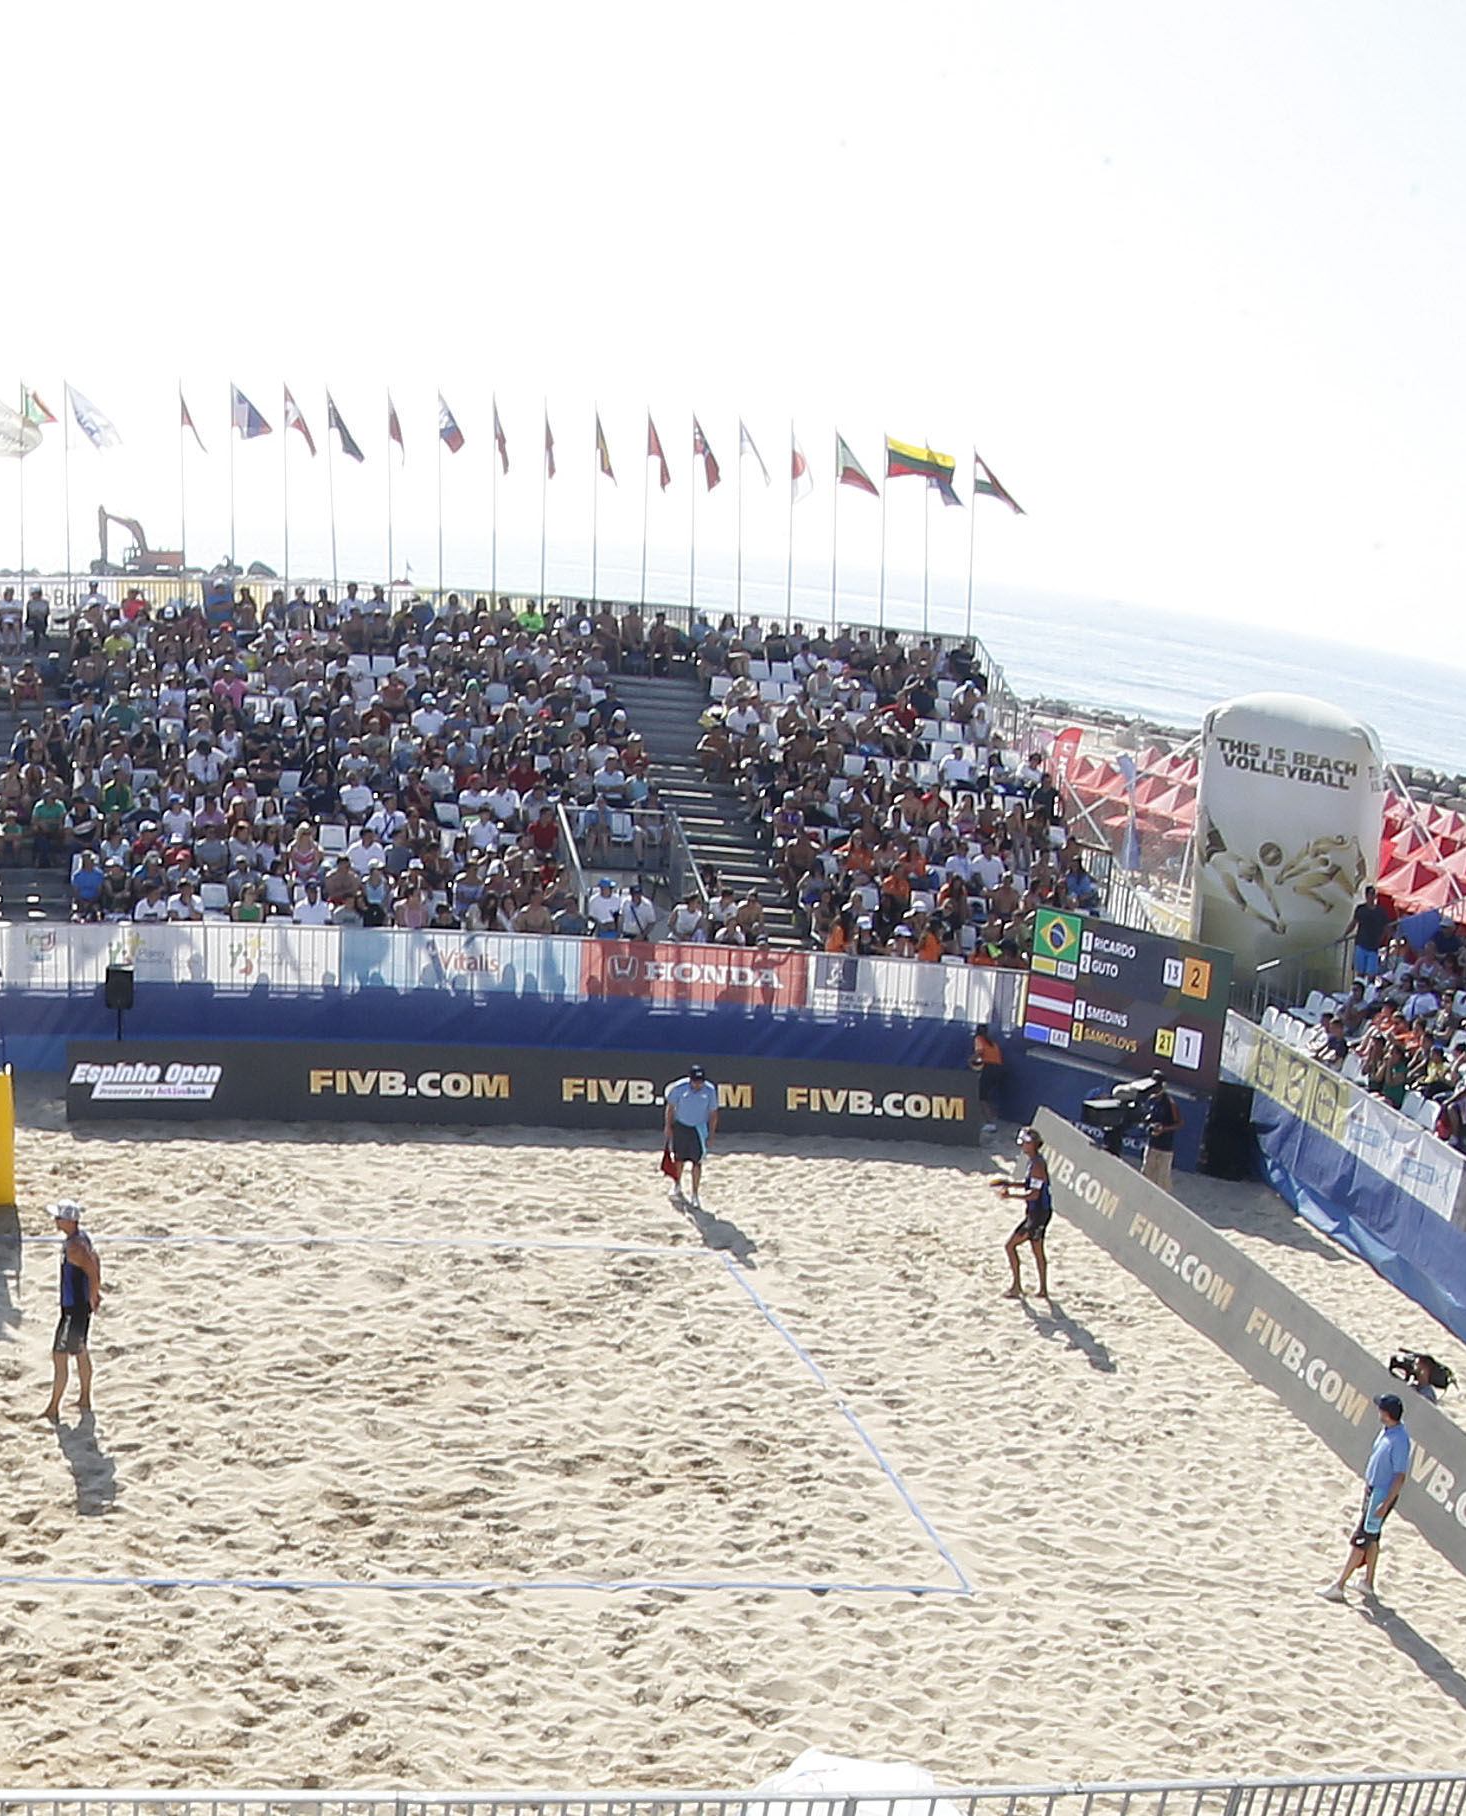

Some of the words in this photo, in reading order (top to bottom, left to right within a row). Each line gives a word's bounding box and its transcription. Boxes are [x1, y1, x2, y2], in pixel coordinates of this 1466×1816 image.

[1217, 736, 1261, 757] THIS
[1268, 746, 1286, 761] IS
[1293, 752, 1358, 777] BEACH
[1222, 753, 1350, 790] VOLLEYBALL
[438, 948, 500, 972] Vitalis
[1093, 936, 1137, 959] RICARDO
[644, 961, 784, 989] HONDA
[1092, 965, 1119, 977] GUTO
[1086, 1006, 1129, 1028] SMEDINS
[69, 1061, 161, 1085] Espinho
[164, 1064, 222, 1084] Open
[308, 1068, 511, 1099] FIVB.COM
[561, 1077, 755, 1110] FIVB.M
[786, 1086, 966, 1121] FIVB.COM
[1128, 1211, 1237, 1313] FIVB.COM
[1243, 1306, 1371, 1428] FIVB.COM
